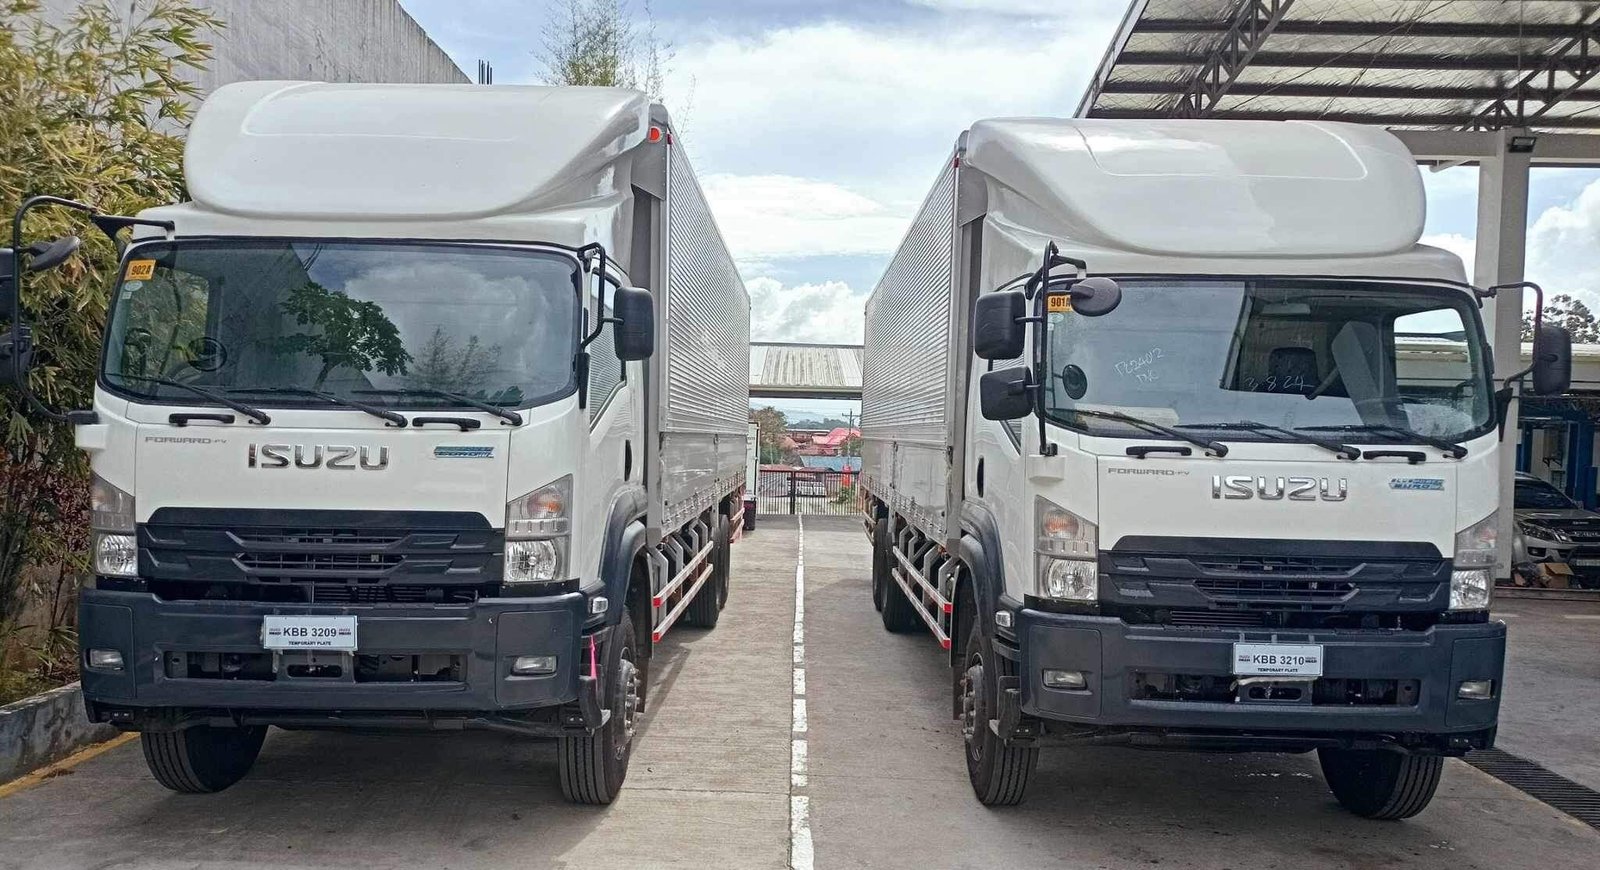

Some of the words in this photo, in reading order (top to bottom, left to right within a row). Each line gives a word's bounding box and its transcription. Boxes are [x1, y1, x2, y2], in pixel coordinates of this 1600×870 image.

[248, 443, 389, 470] ISUZU
[1212, 475, 1348, 502] ISUZU
[283, 627, 308, 637] KBB
[311, 628, 337, 637] 3209
[1253, 655, 1276, 664] KBB
[1280, 656, 1304, 665] 3210
